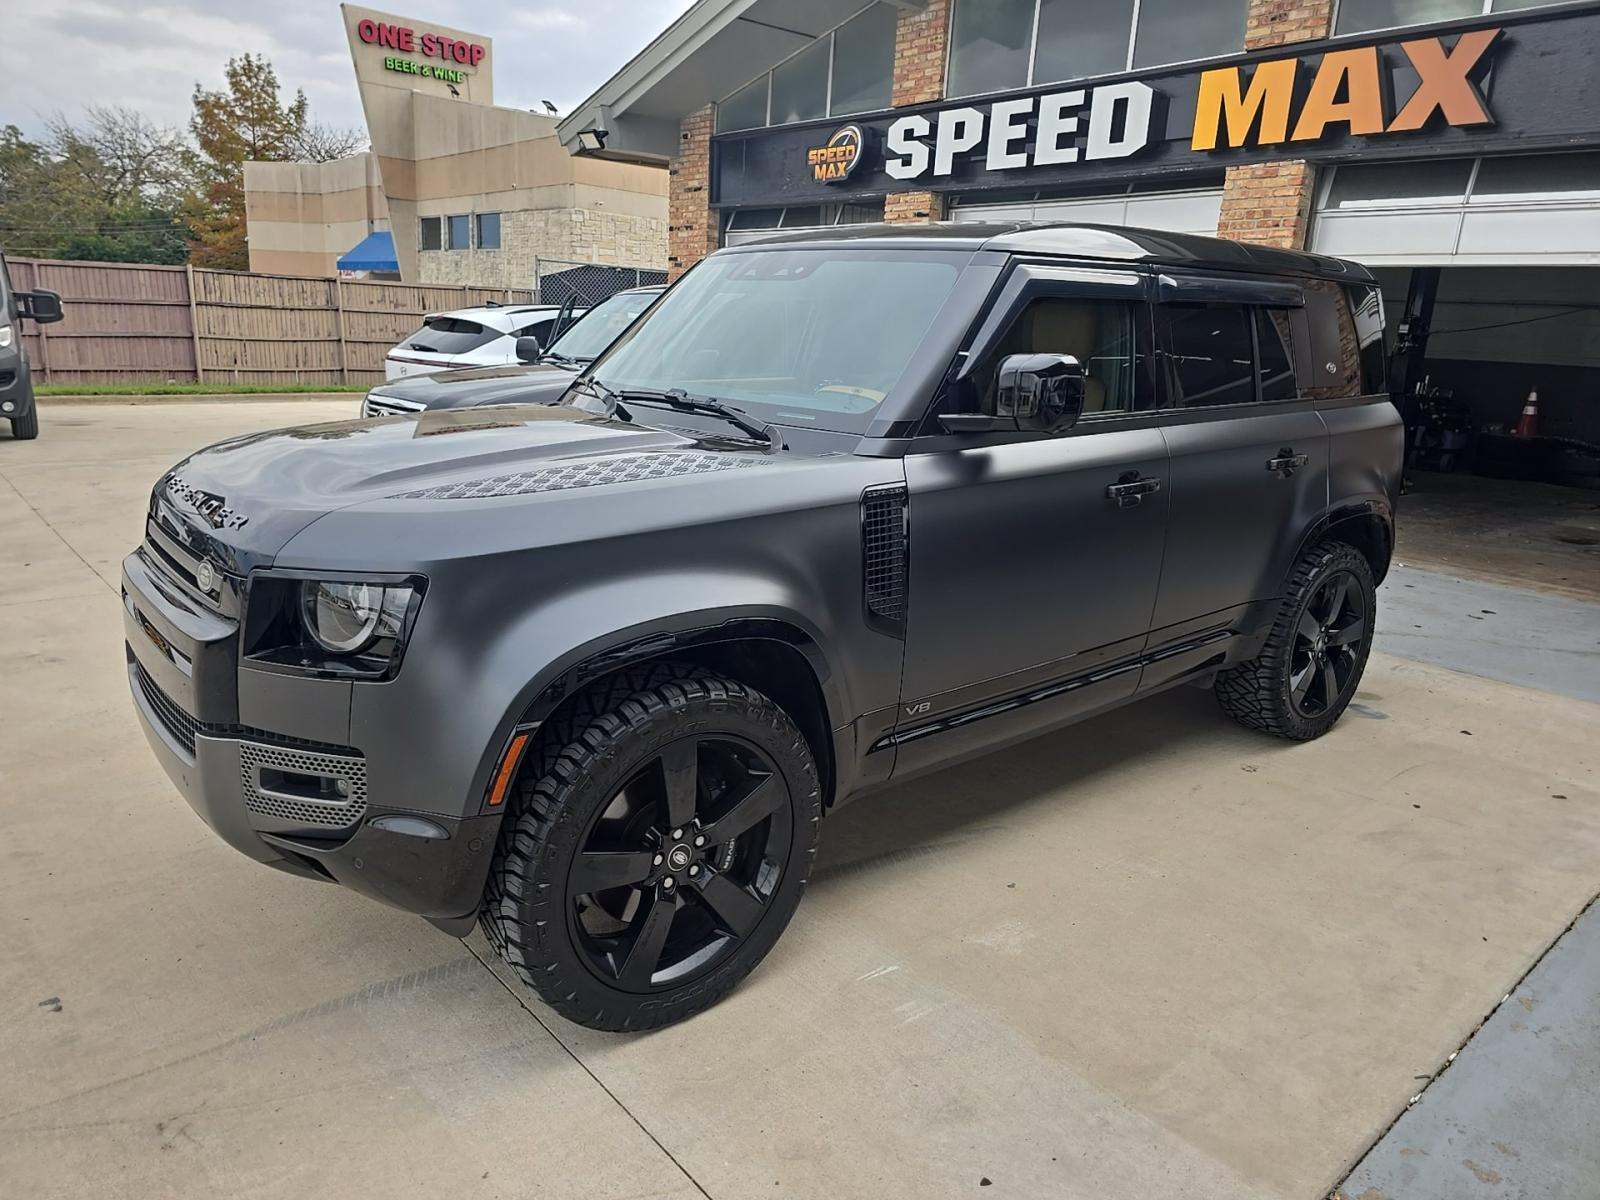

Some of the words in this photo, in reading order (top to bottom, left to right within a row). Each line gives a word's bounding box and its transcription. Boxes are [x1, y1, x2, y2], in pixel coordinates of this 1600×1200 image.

[358, 18, 415, 52] ONE
[420, 33, 486, 66] STOP
[385, 57, 418, 75] BEER
[421, 66, 430, 78] &
[433, 67, 465, 83] WINE
[885, 81, 1154, 180] SPEED
[1190, 27, 1502, 151] MAX
[807, 144, 856, 165] SPEED
[814, 161, 847, 181] MAX
[905, 702, 930, 715] V8
